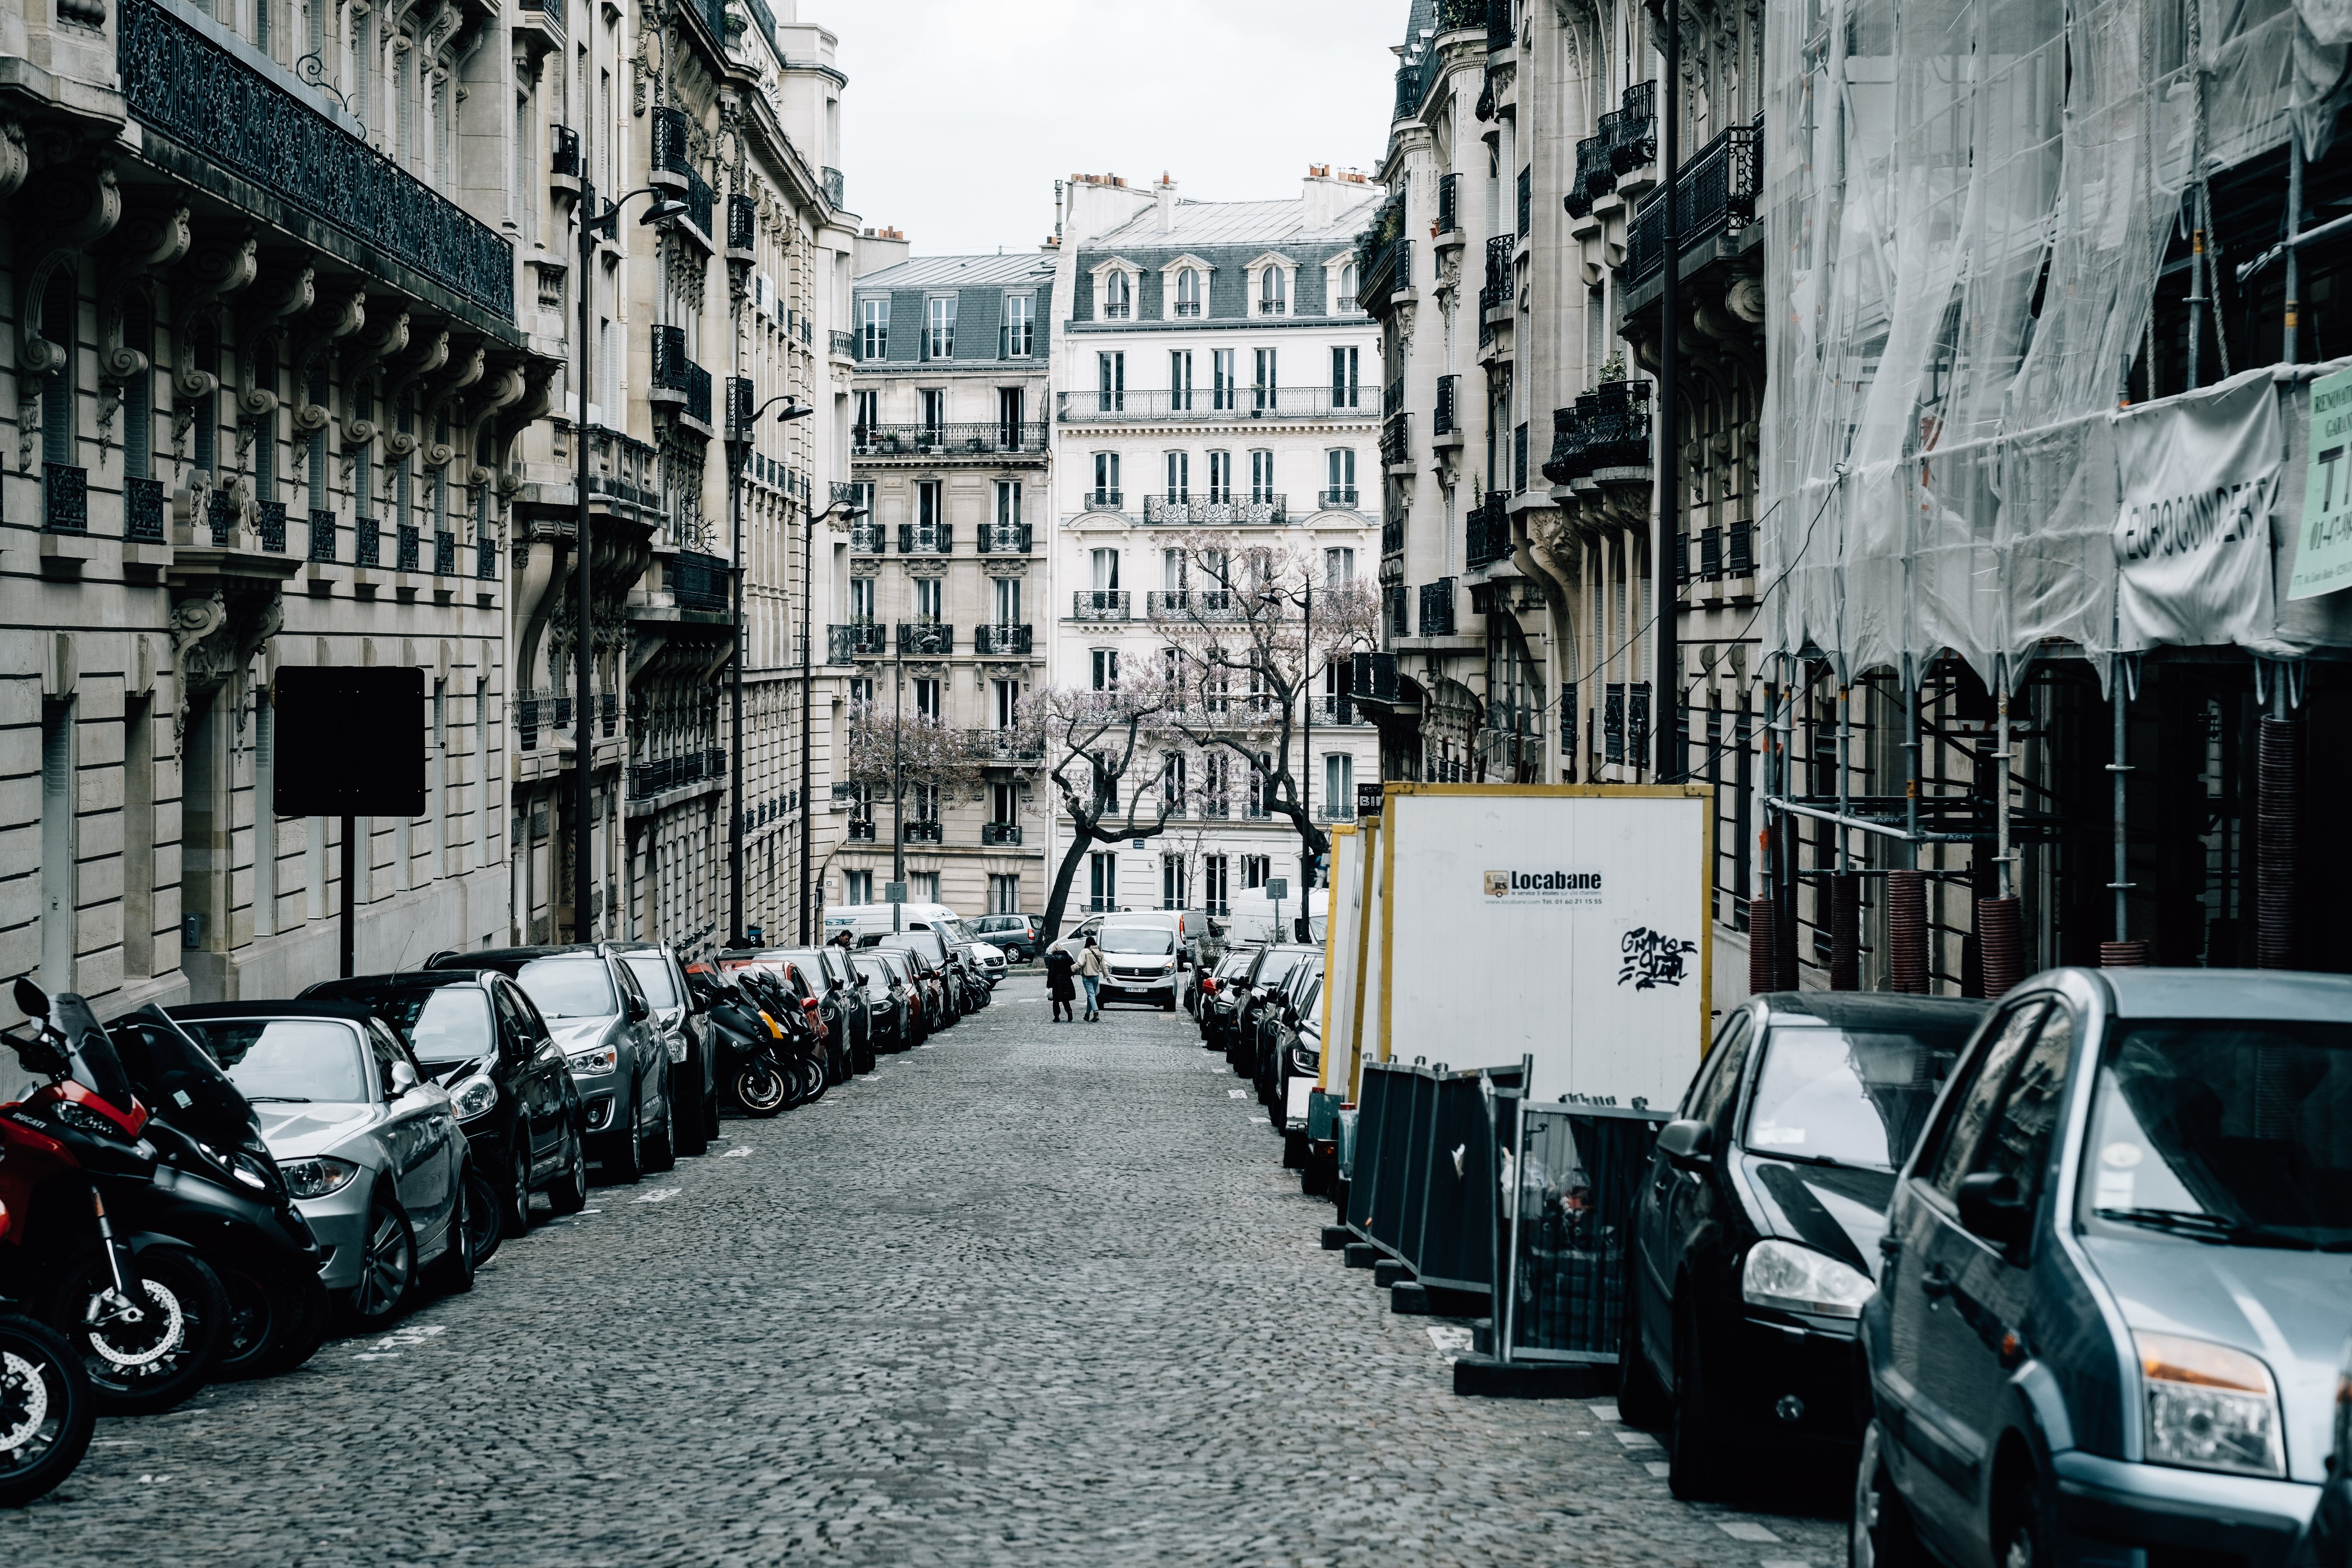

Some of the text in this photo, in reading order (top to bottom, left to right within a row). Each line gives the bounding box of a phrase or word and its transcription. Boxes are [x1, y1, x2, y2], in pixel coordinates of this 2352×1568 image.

[2126, 477, 2268, 560] EUROCONCERT
[1511, 871, 1601, 889] Locabane
[12, 1112, 47, 1129] DUCATI
